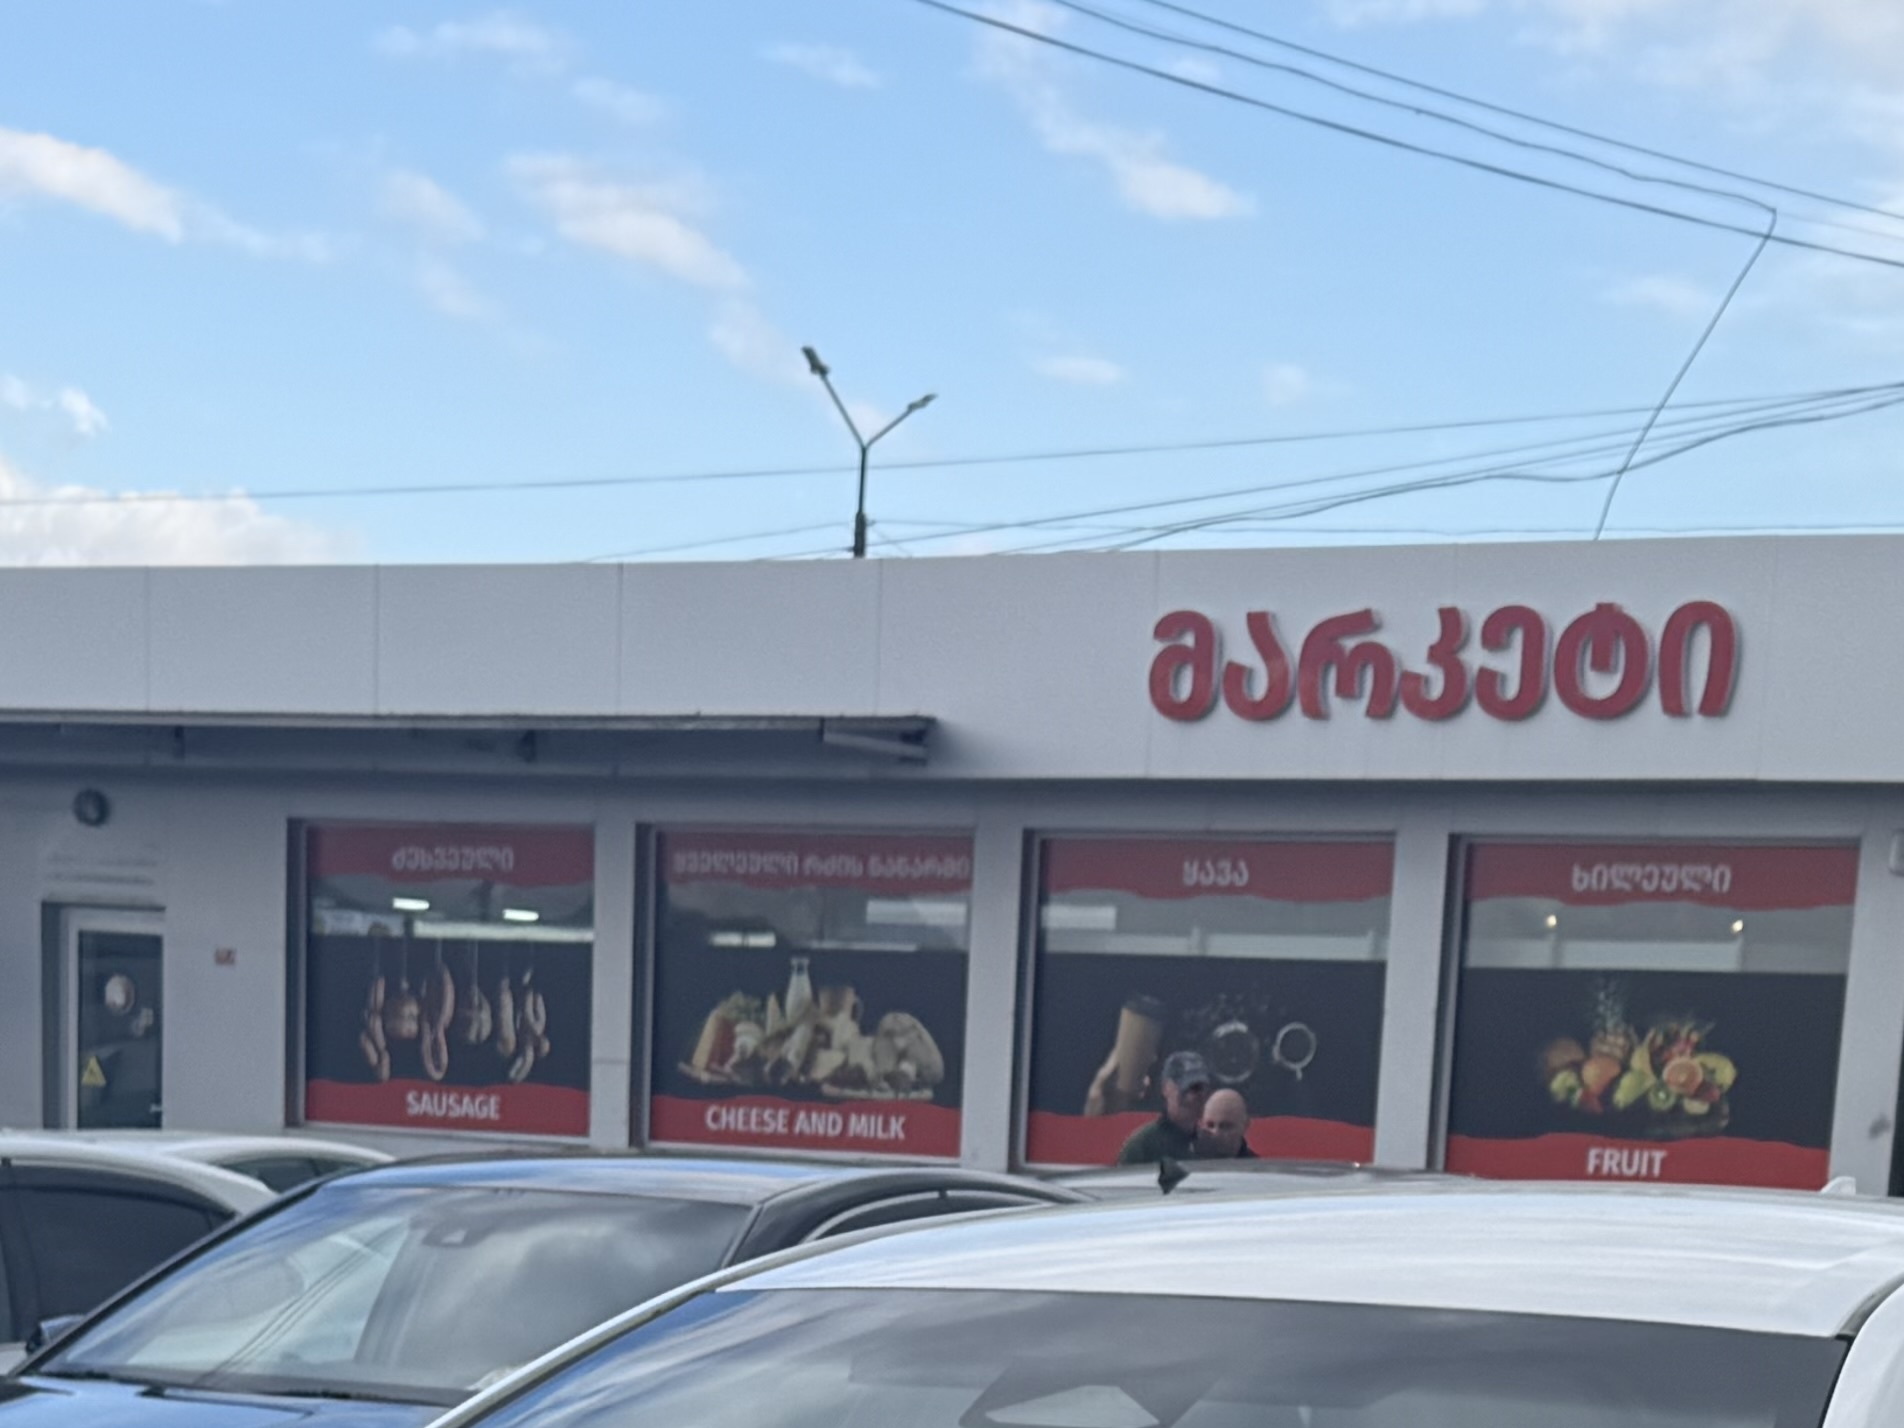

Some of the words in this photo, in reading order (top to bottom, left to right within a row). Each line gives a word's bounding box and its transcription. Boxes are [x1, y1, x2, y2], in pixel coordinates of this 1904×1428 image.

[1148, 599, 1738, 722] მარკეტი
[1182, 857, 1250, 888] ყავა
[1571, 861, 1732, 893] ხილეული
[405, 1090, 502, 1121] SAUSAGE
[704, 1104, 789, 1135] CHEESE
[794, 1108, 844, 1138] AND
[848, 1111, 906, 1141] MILK
[1586, 1147, 1667, 1178] FRUIT
